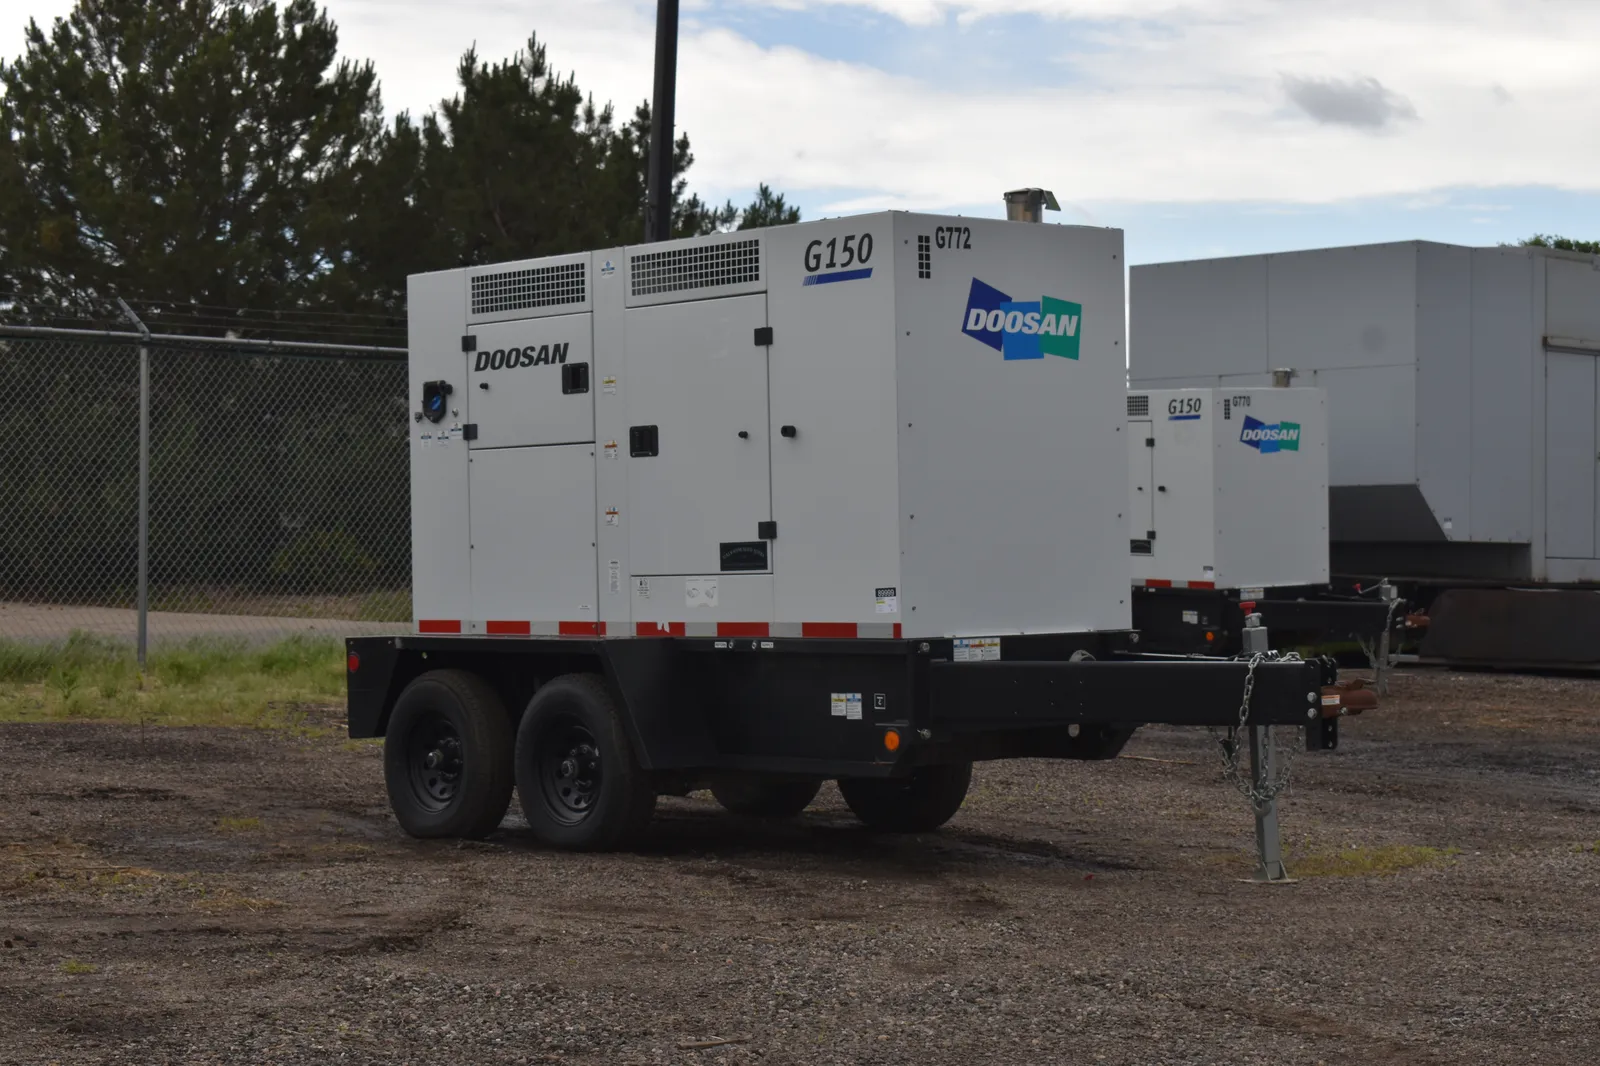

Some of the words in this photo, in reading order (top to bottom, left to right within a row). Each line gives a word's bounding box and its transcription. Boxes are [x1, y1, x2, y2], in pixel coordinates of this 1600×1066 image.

[935, 226, 972, 249] G772
[804, 233, 873, 272] G150
[966, 308, 1079, 337] DOOSAN
[474, 343, 569, 371] DOOSAN
[1168, 398, 1202, 414] G150
[1232, 396, 1251, 406] G770
[1242, 429, 1298, 441] DOOSAN
